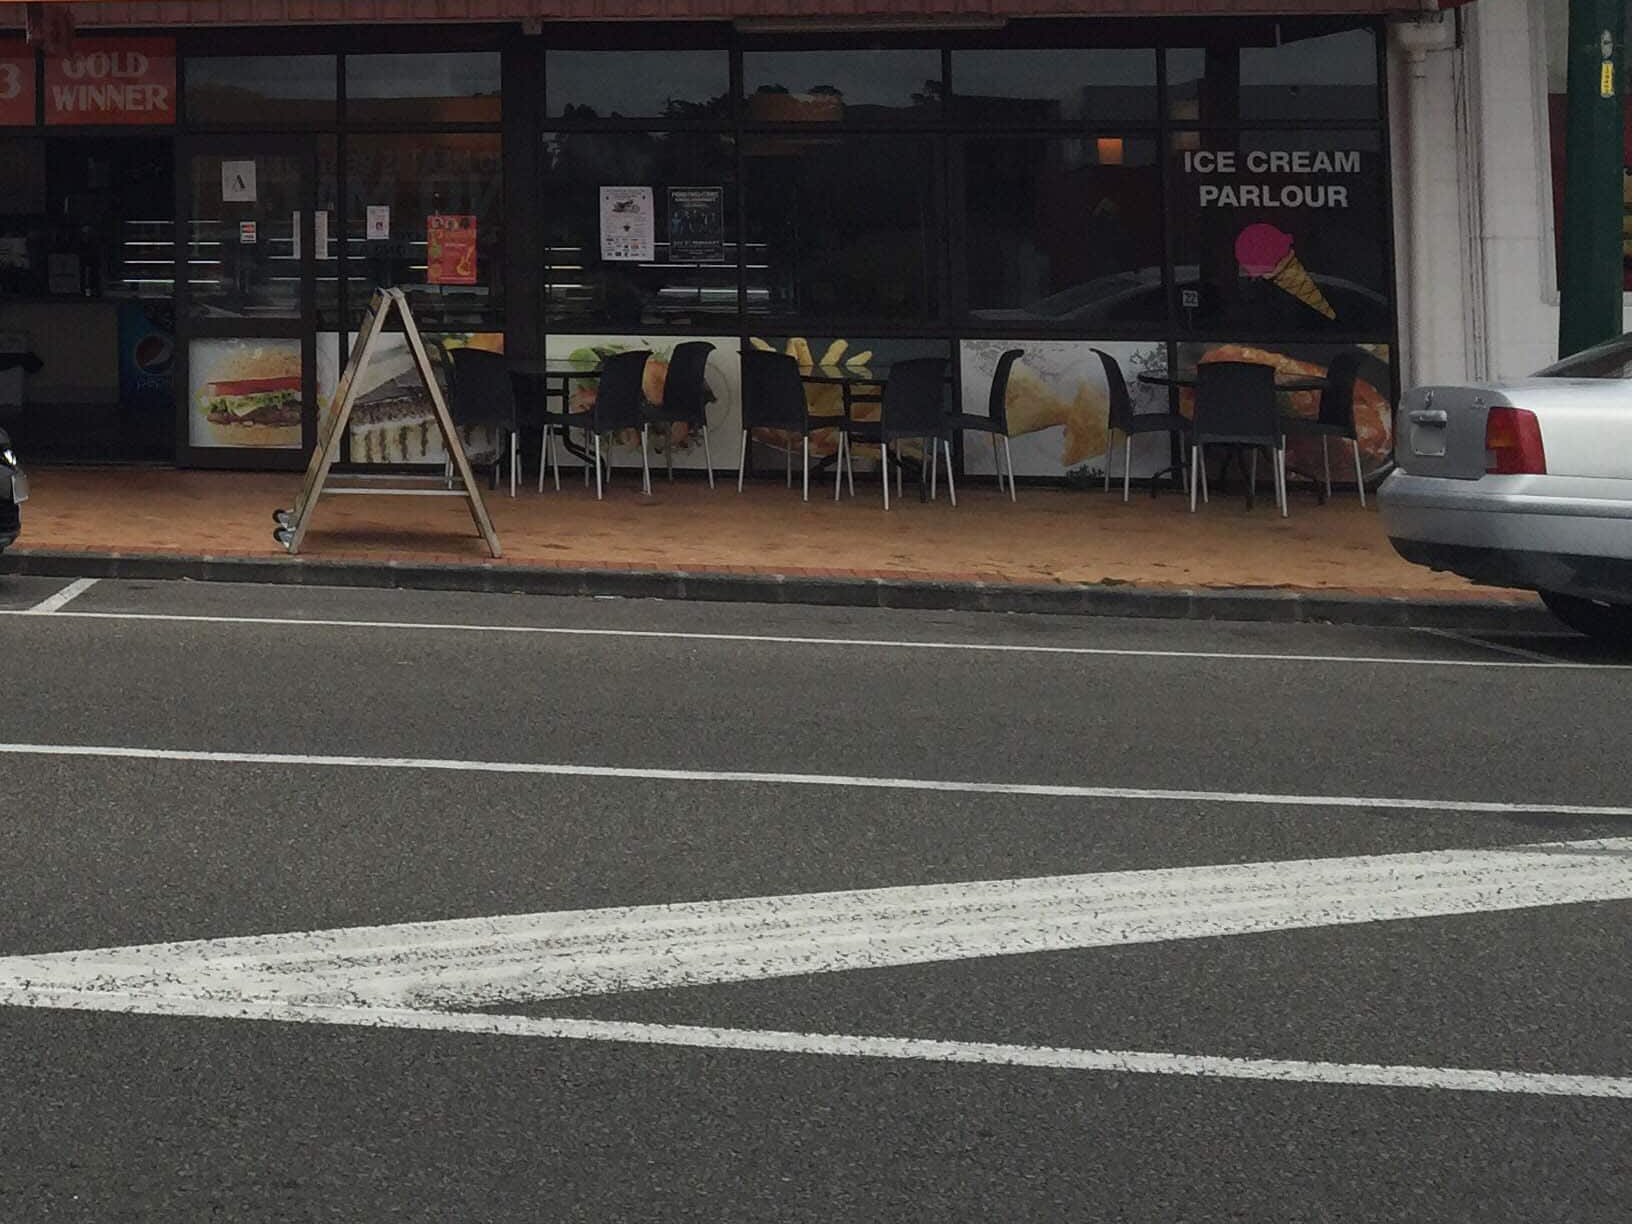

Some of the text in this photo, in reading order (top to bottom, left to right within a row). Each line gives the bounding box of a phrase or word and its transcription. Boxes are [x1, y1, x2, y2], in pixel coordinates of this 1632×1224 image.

[62, 51, 150, 79] GOLD
[50, 83, 169, 112] WINNER
[1183, 150, 1361, 173] ICE CREAM
[1199, 184, 1349, 208] PARLOUR
